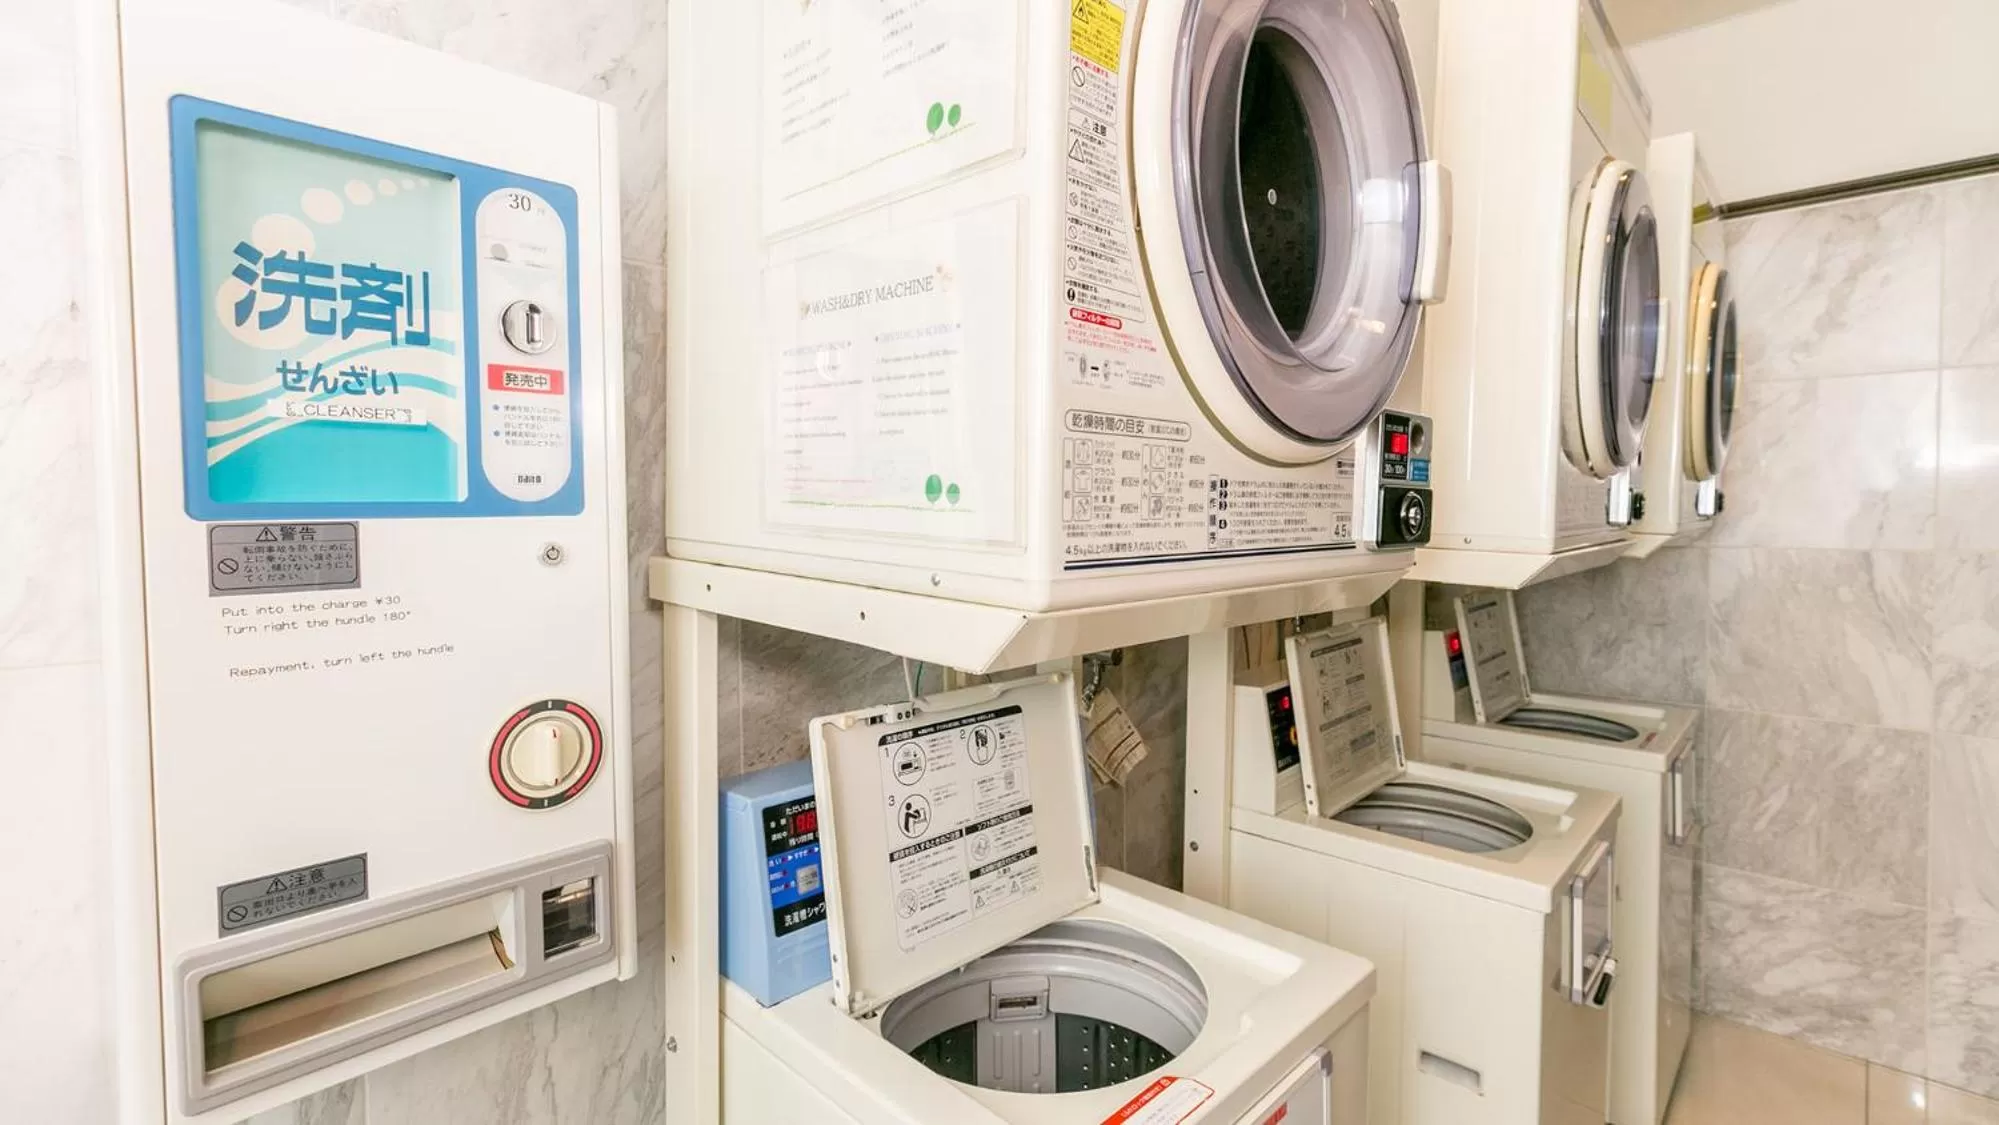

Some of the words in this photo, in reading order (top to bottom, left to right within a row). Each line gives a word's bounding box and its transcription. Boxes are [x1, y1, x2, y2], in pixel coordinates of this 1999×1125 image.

[508, 193, 532, 212] 30
[232, 241, 431, 346] 洗剤
[875, 275, 935, 303] MACHINE
[276, 359, 400, 396] せんざい
[505, 372, 548, 388] 発売中
[303, 404, 396, 420] CLEANSER
[280, 526, 317, 541] 警告
[222, 607, 249, 618] Put
[256, 606, 284, 615] into
[292, 602, 315, 613] the
[322, 598, 368, 611] charge
[224, 624, 257, 636] Turn
[263, 621, 299, 633] right
[306, 618, 329, 629] the
[324, 656, 352, 668] turn
[359, 651, 385, 664] left
[391, 648, 412, 660] the
[888, 795, 895, 806] 3
[289, 868, 325, 888] 注意
